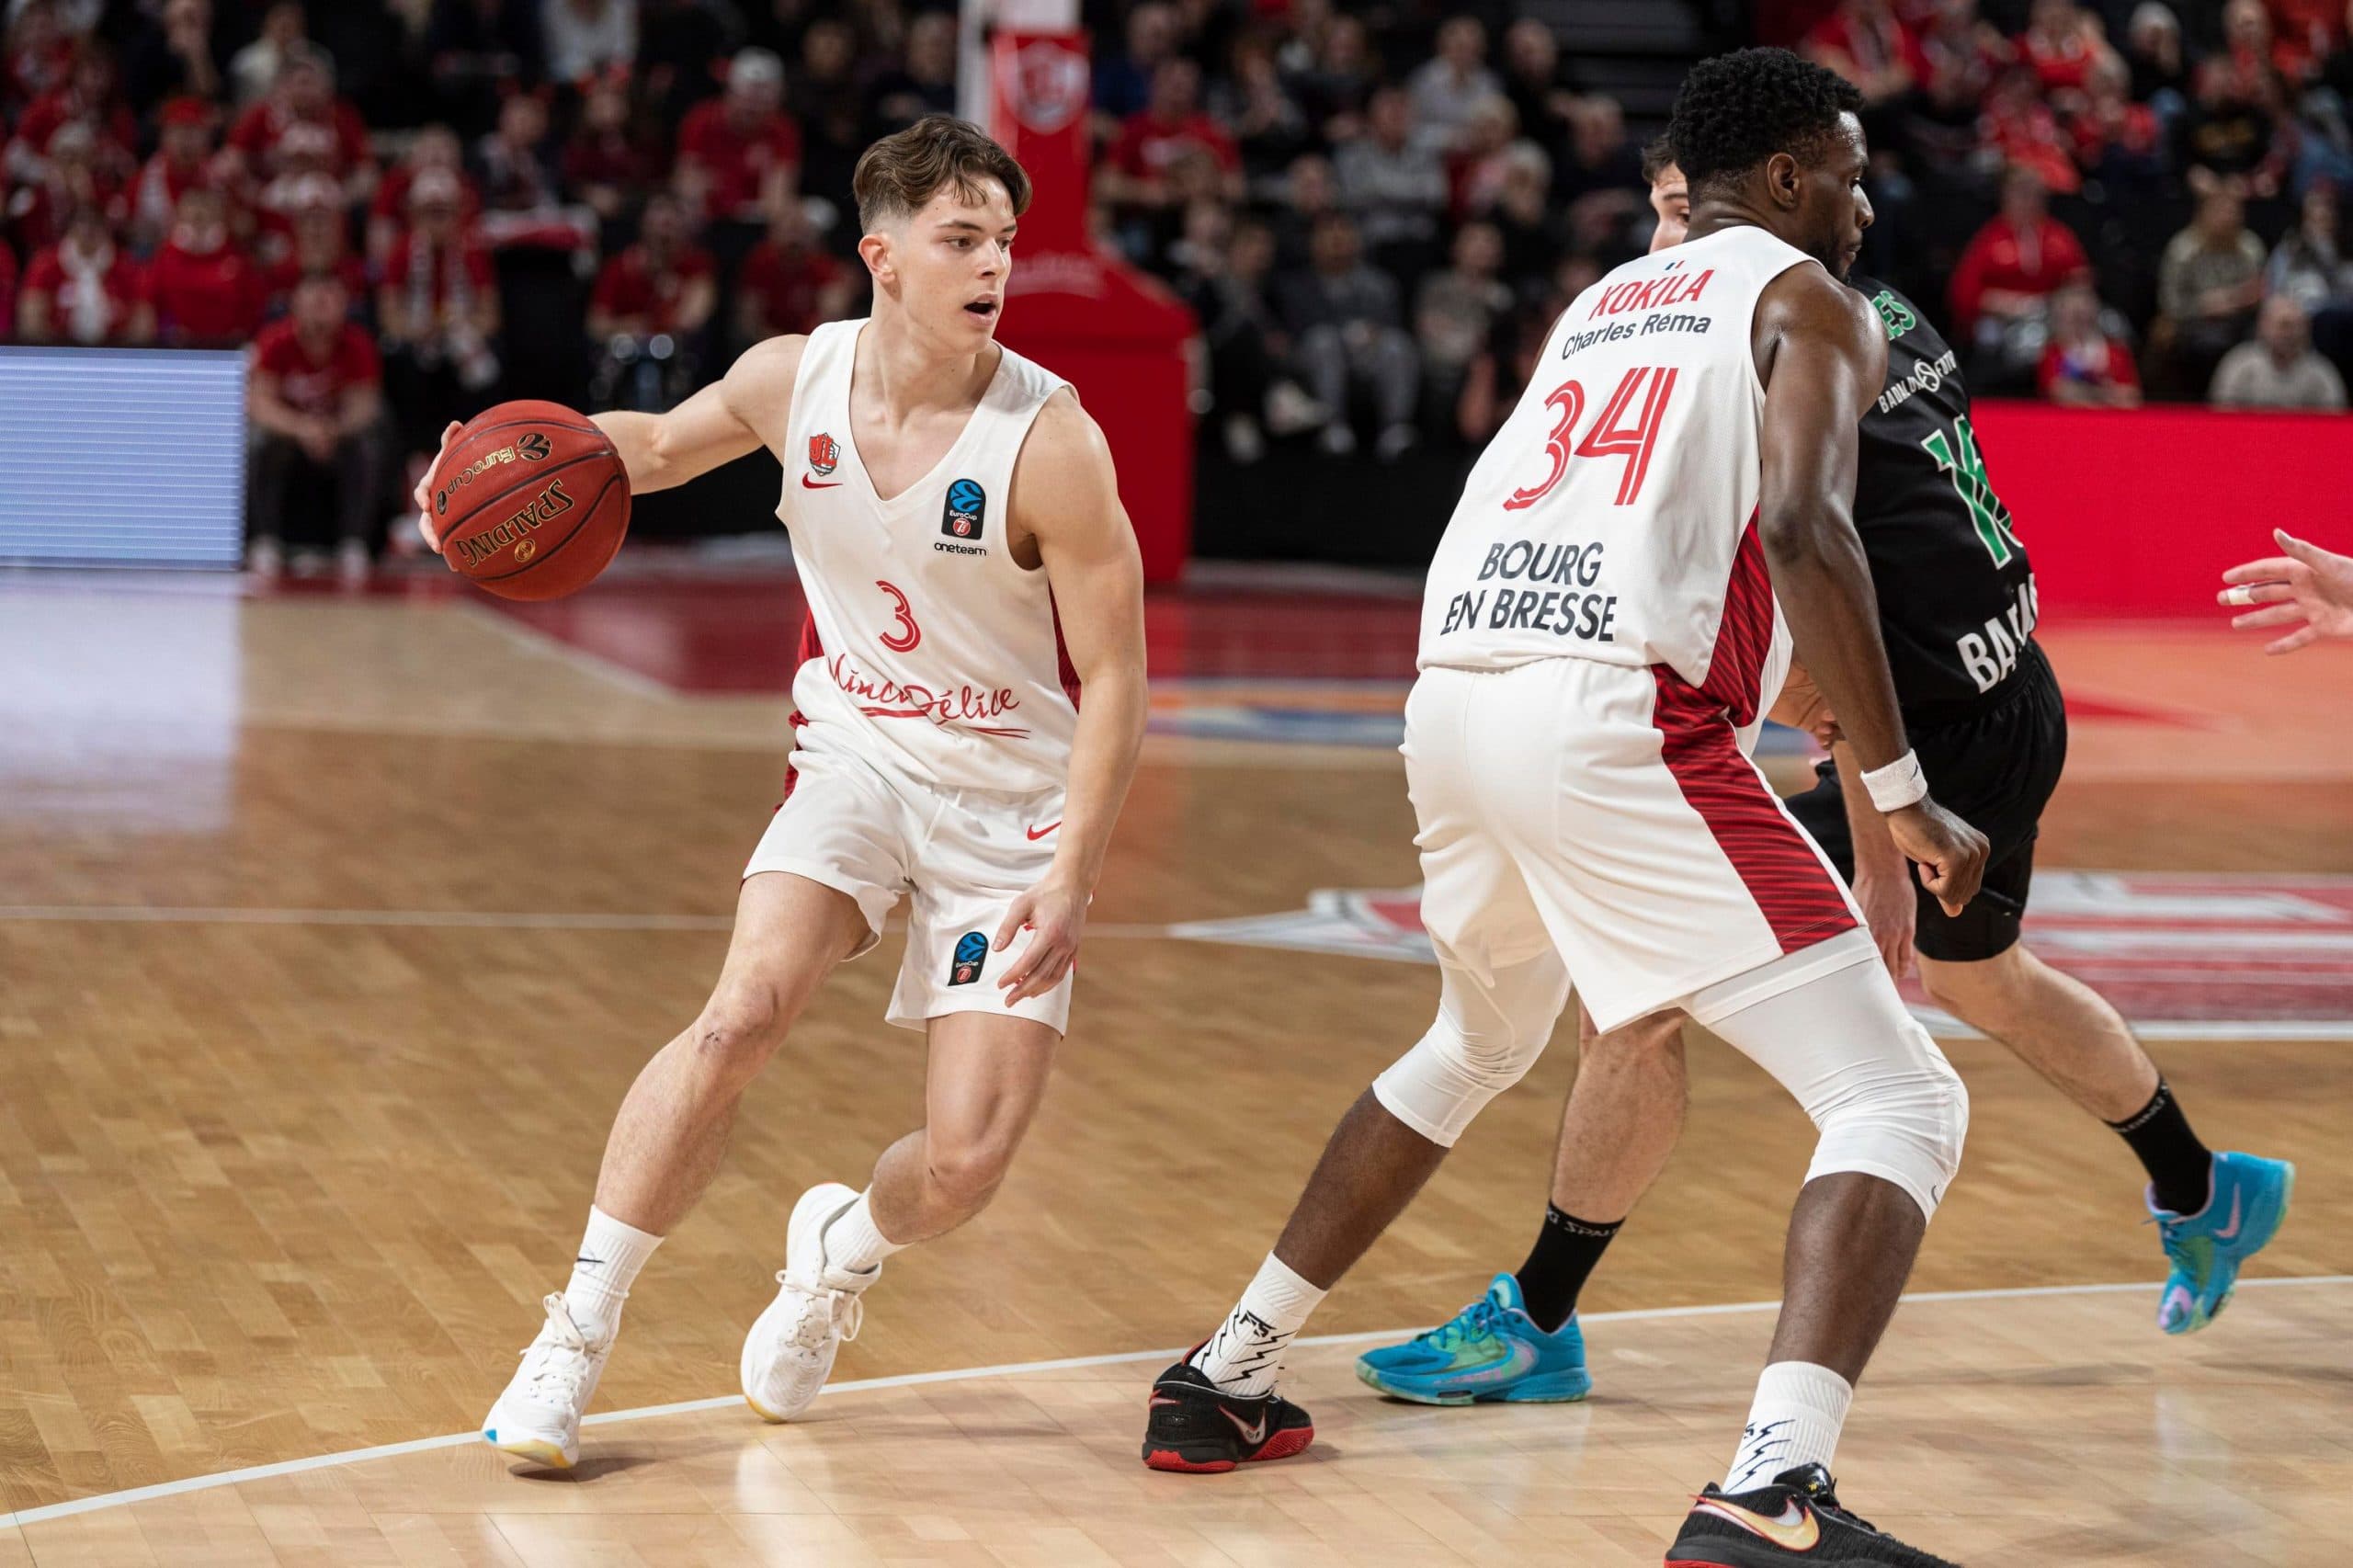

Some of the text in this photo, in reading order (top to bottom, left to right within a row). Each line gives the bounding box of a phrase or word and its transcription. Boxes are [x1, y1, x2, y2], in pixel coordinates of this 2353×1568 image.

[1588, 269, 1714, 321] KOKILA
[1563, 313, 1711, 360] Charles Réma
[1502, 366, 1679, 512] 34
[447, 446, 516, 494] EuroCup
[455, 478, 574, 568] SPALDING
[949, 509, 978, 521] EuroCup
[934, 542, 987, 556] oneteam
[1477, 540, 1604, 587] BOURG
[875, 580, 921, 653] 3
[1439, 588, 1618, 642] EN BRESSE
